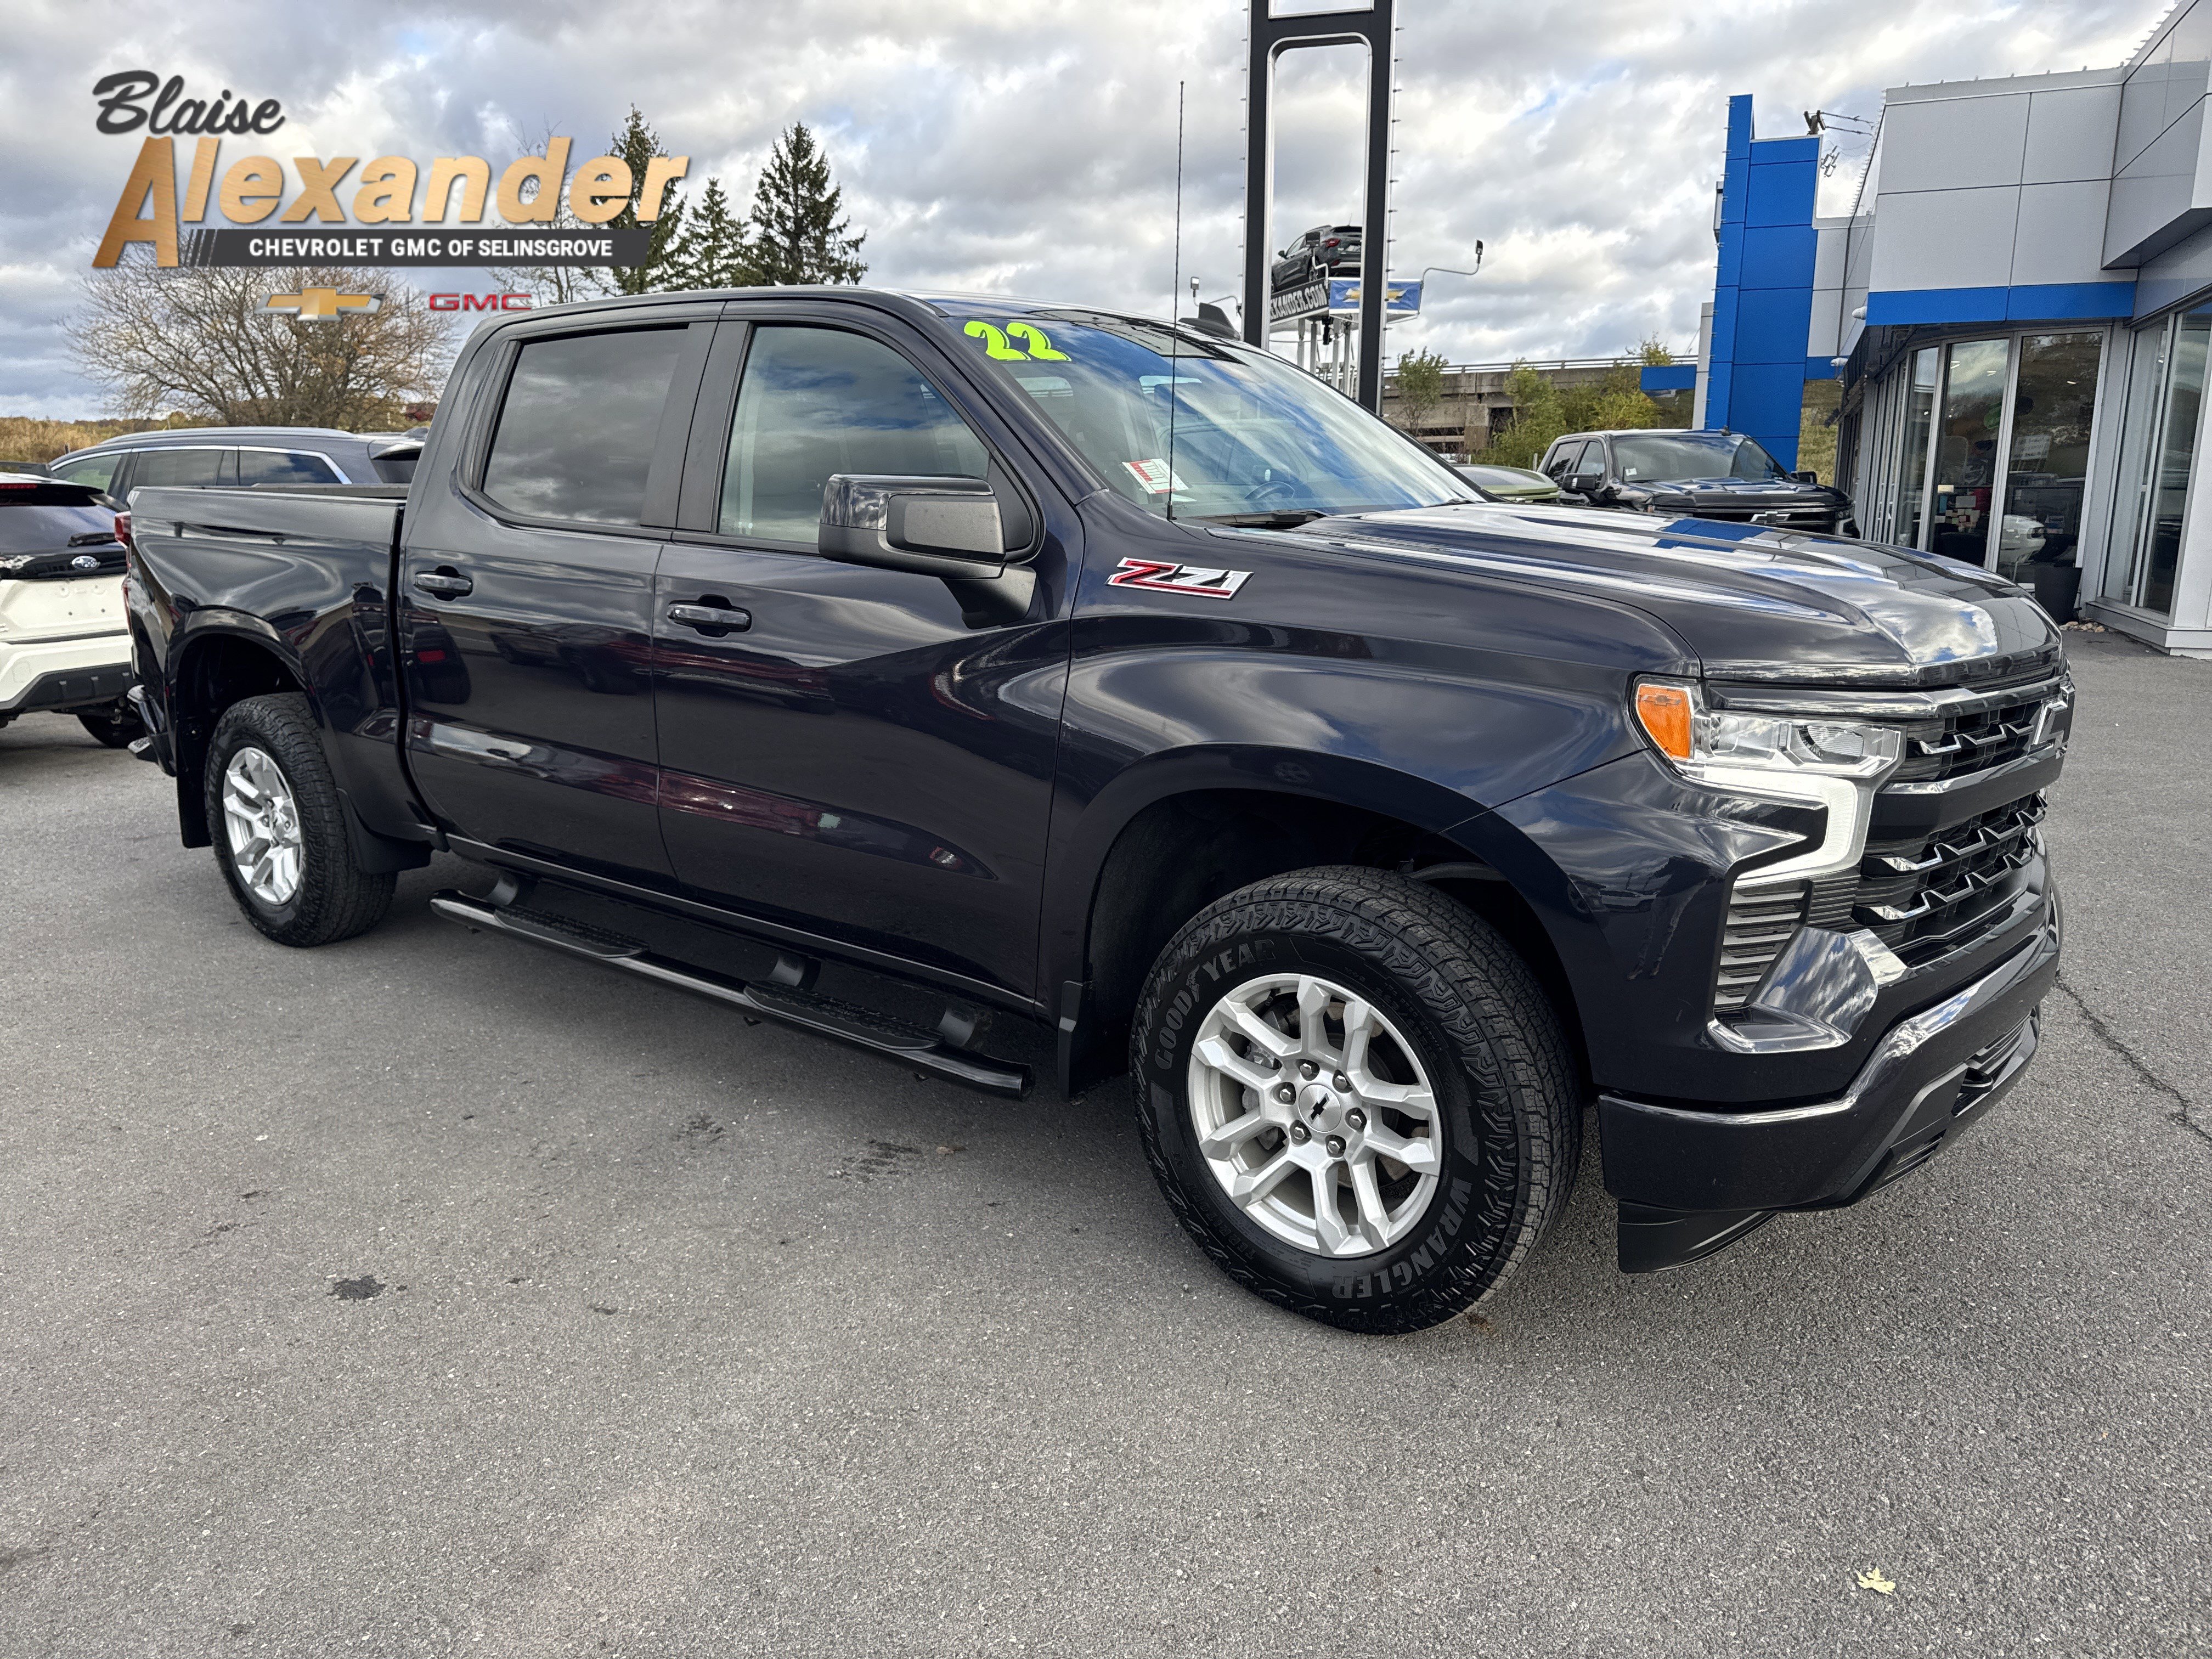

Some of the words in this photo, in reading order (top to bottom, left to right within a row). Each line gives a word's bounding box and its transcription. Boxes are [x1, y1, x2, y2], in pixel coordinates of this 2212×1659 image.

[1270, 284, 1328, 320] EXANDER.COM
[964, 321, 1072, 362] 22
[1104, 556, 1254, 600] Z71
[1331, 1177, 1473, 1299] WRANGLER
